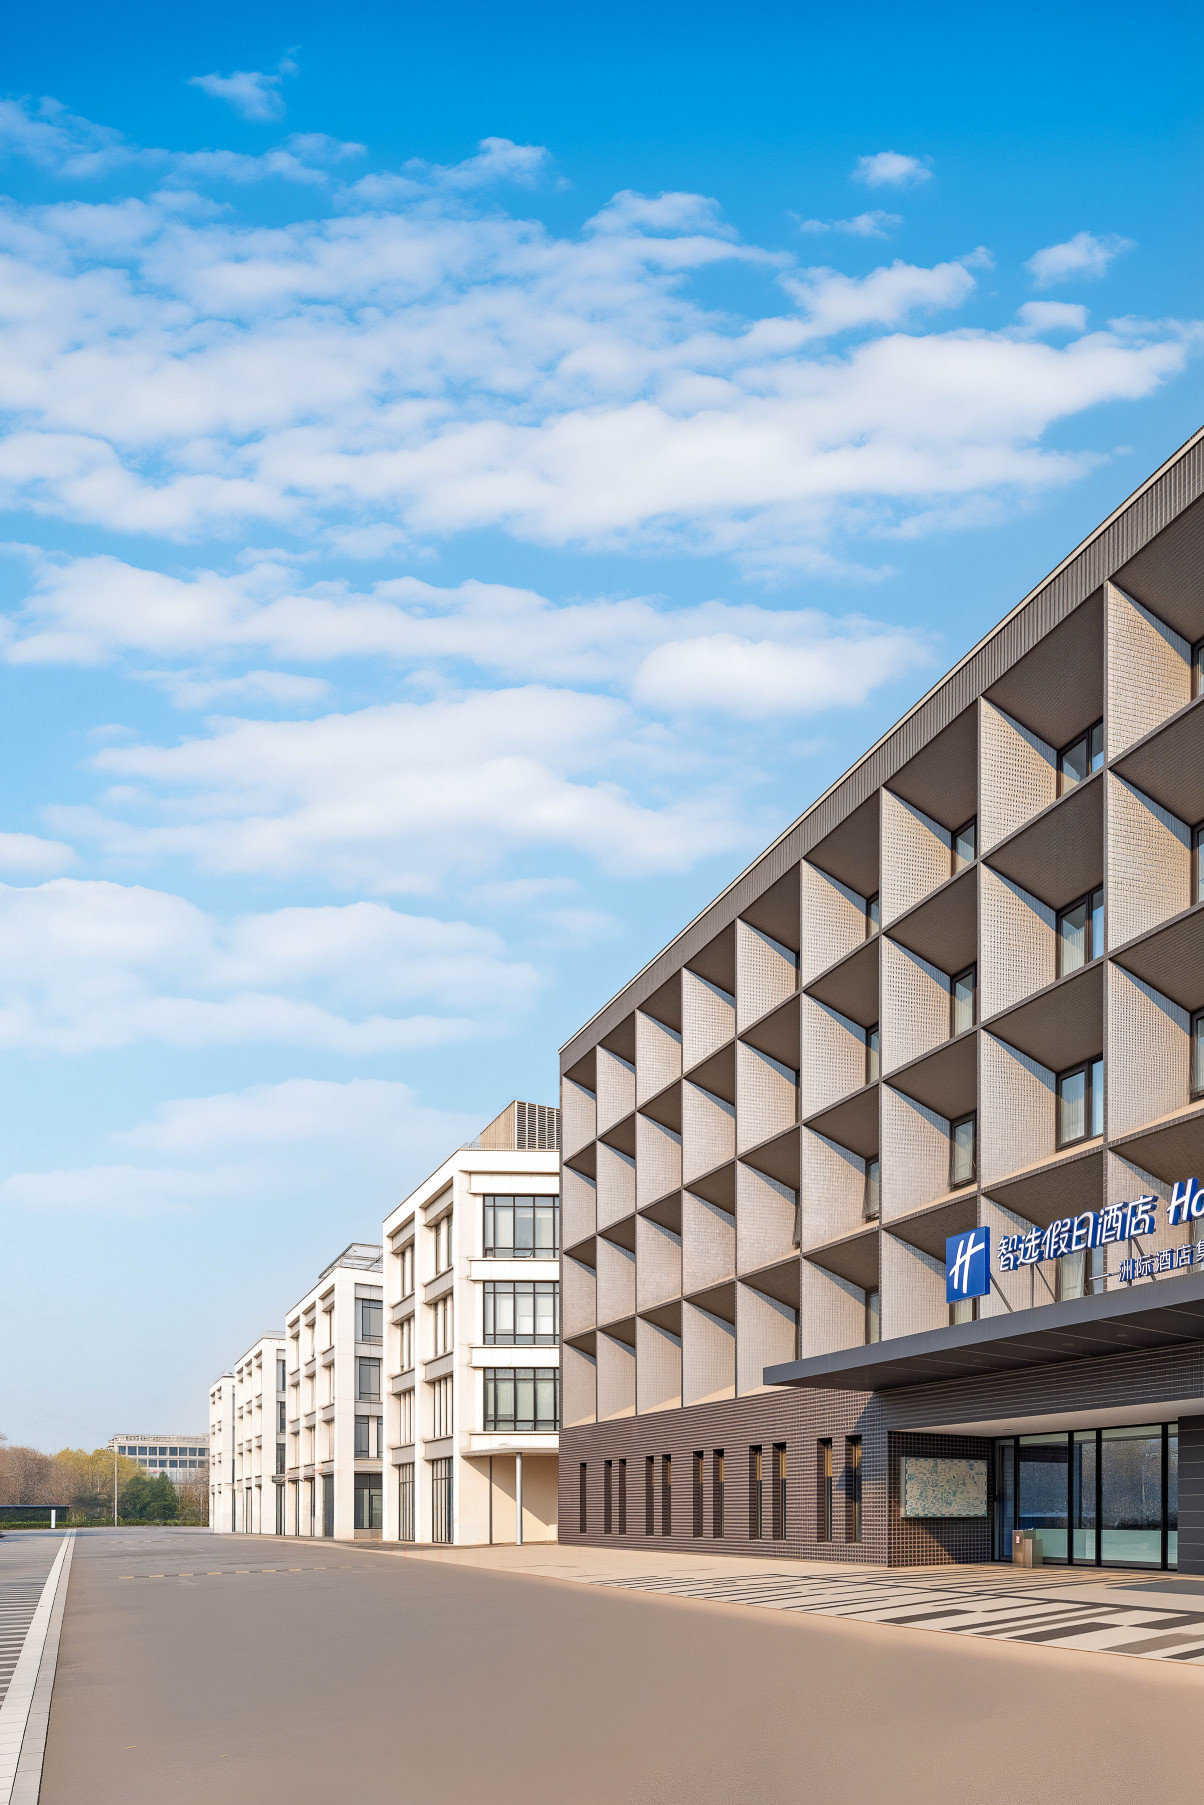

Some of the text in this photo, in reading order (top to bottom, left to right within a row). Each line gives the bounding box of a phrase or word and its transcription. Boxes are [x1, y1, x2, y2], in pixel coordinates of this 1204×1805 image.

[997, 1195, 1157, 1273] 智选假日酒店
